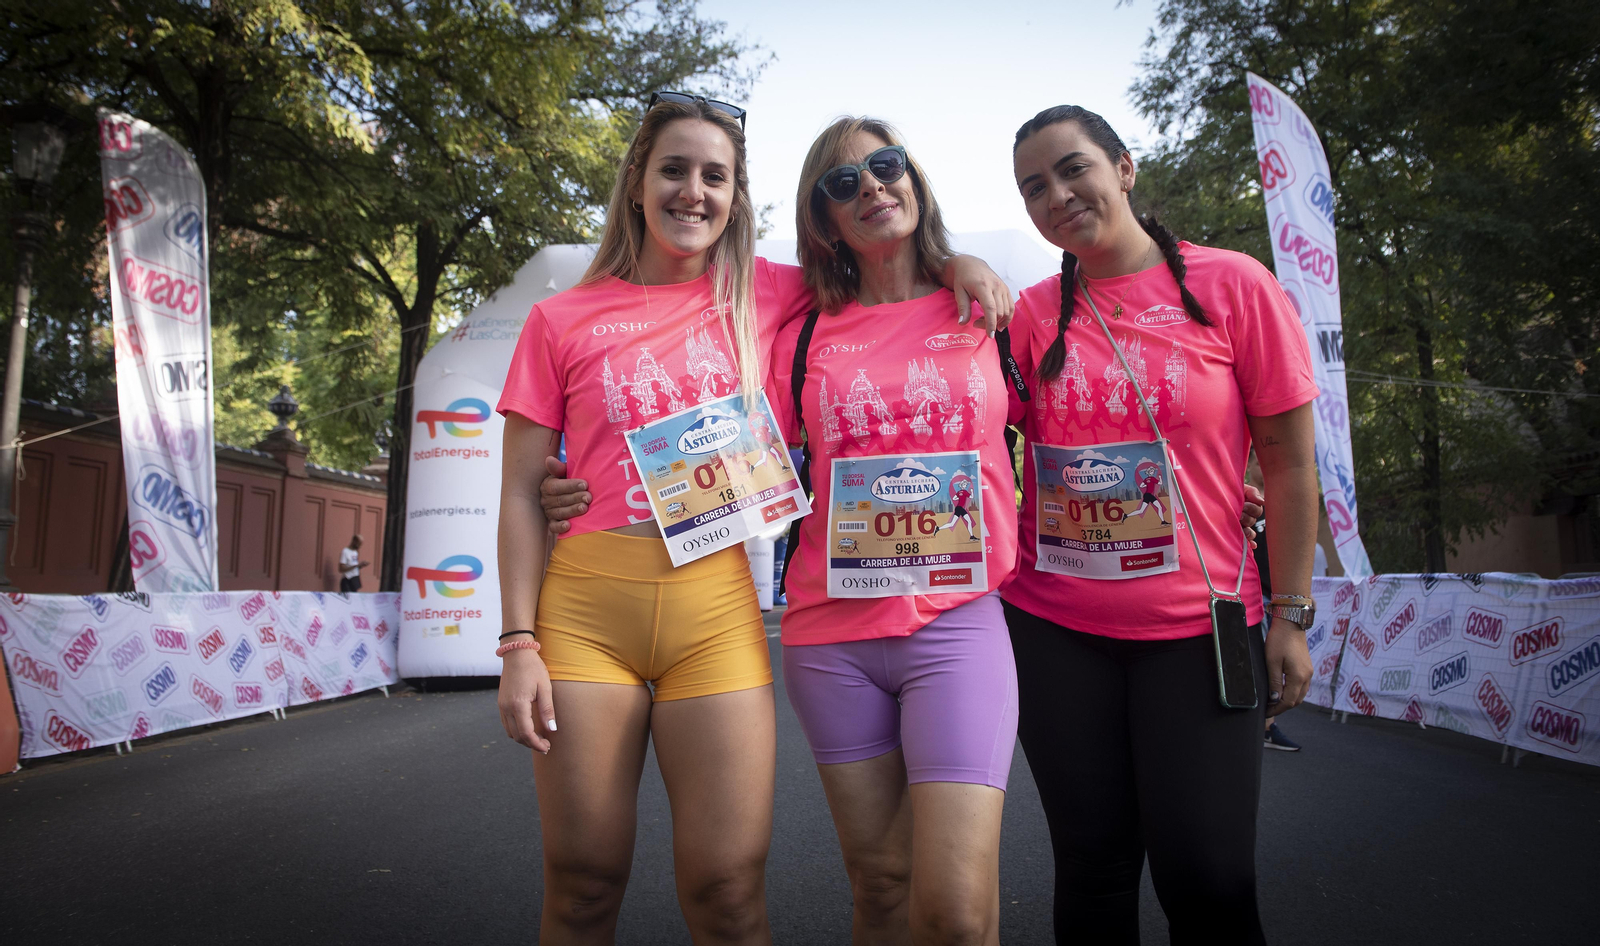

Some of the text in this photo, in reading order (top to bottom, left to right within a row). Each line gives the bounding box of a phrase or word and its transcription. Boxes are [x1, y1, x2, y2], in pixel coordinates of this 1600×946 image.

[1139, 313, 1187, 324] ASTURIANA
[819, 340, 877, 358] OYSHO
[643, 441, 670, 456] SUMA
[684, 426, 739, 452] ASTURIANA
[413, 446, 490, 460] TotalEnergies
[842, 479, 865, 487] SUMA
[875, 481, 937, 495] ASTURIANA
[1065, 470, 1121, 485] ASTURIANA
[719, 484, 747, 502] 1851
[694, 507, 731, 525] CARRERA
[731, 500, 743, 512] DE
[743, 498, 752, 507] LA
[752, 489, 776, 504] MUJER
[1068, 498, 1125, 523] 016
[874, 510, 937, 537] 016
[1081, 529, 1112, 540] 3784
[682, 526, 731, 552] OYSHO
[895, 542, 920, 555] 998
[1061, 538, 1143, 552] CARRERA DE LA MUJER
[860, 555, 952, 568] CARRERA DE LA MUJER
[1047, 553, 1084, 570] OYSHO
[1133, 556, 1159, 566] Santander
[842, 577, 891, 589] OYSHO
[940, 573, 967, 581] Santander
[240, 592, 266, 621] COSMO
[403, 606, 483, 621] TotalEnergies
[1384, 602, 1415, 646] COSMO
[1418, 615, 1451, 651] COSMO
[1466, 611, 1502, 643] COSMO
[63, 628, 98, 673] COSMO
[154, 628, 188, 650] COSMO
[198, 629, 226, 660] COSMO
[1349, 625, 1375, 661] COSMO
[1513, 622, 1559, 660] COSMO
[111, 636, 146, 671] COSMO
[229, 639, 253, 674] COSMO
[1551, 641, 1600, 691] COSMO
[146, 666, 176, 701] COSMO
[1380, 669, 1411, 692] COSMO
[1432, 656, 1467, 690] COSMO
[192, 678, 223, 714] COSMO
[235, 685, 262, 704] COSMO
[1349, 680, 1377, 716] COSMO
[1478, 679, 1511, 732] COSMO
[47, 715, 91, 751] COSMO
[1531, 706, 1580, 746] COSMO
